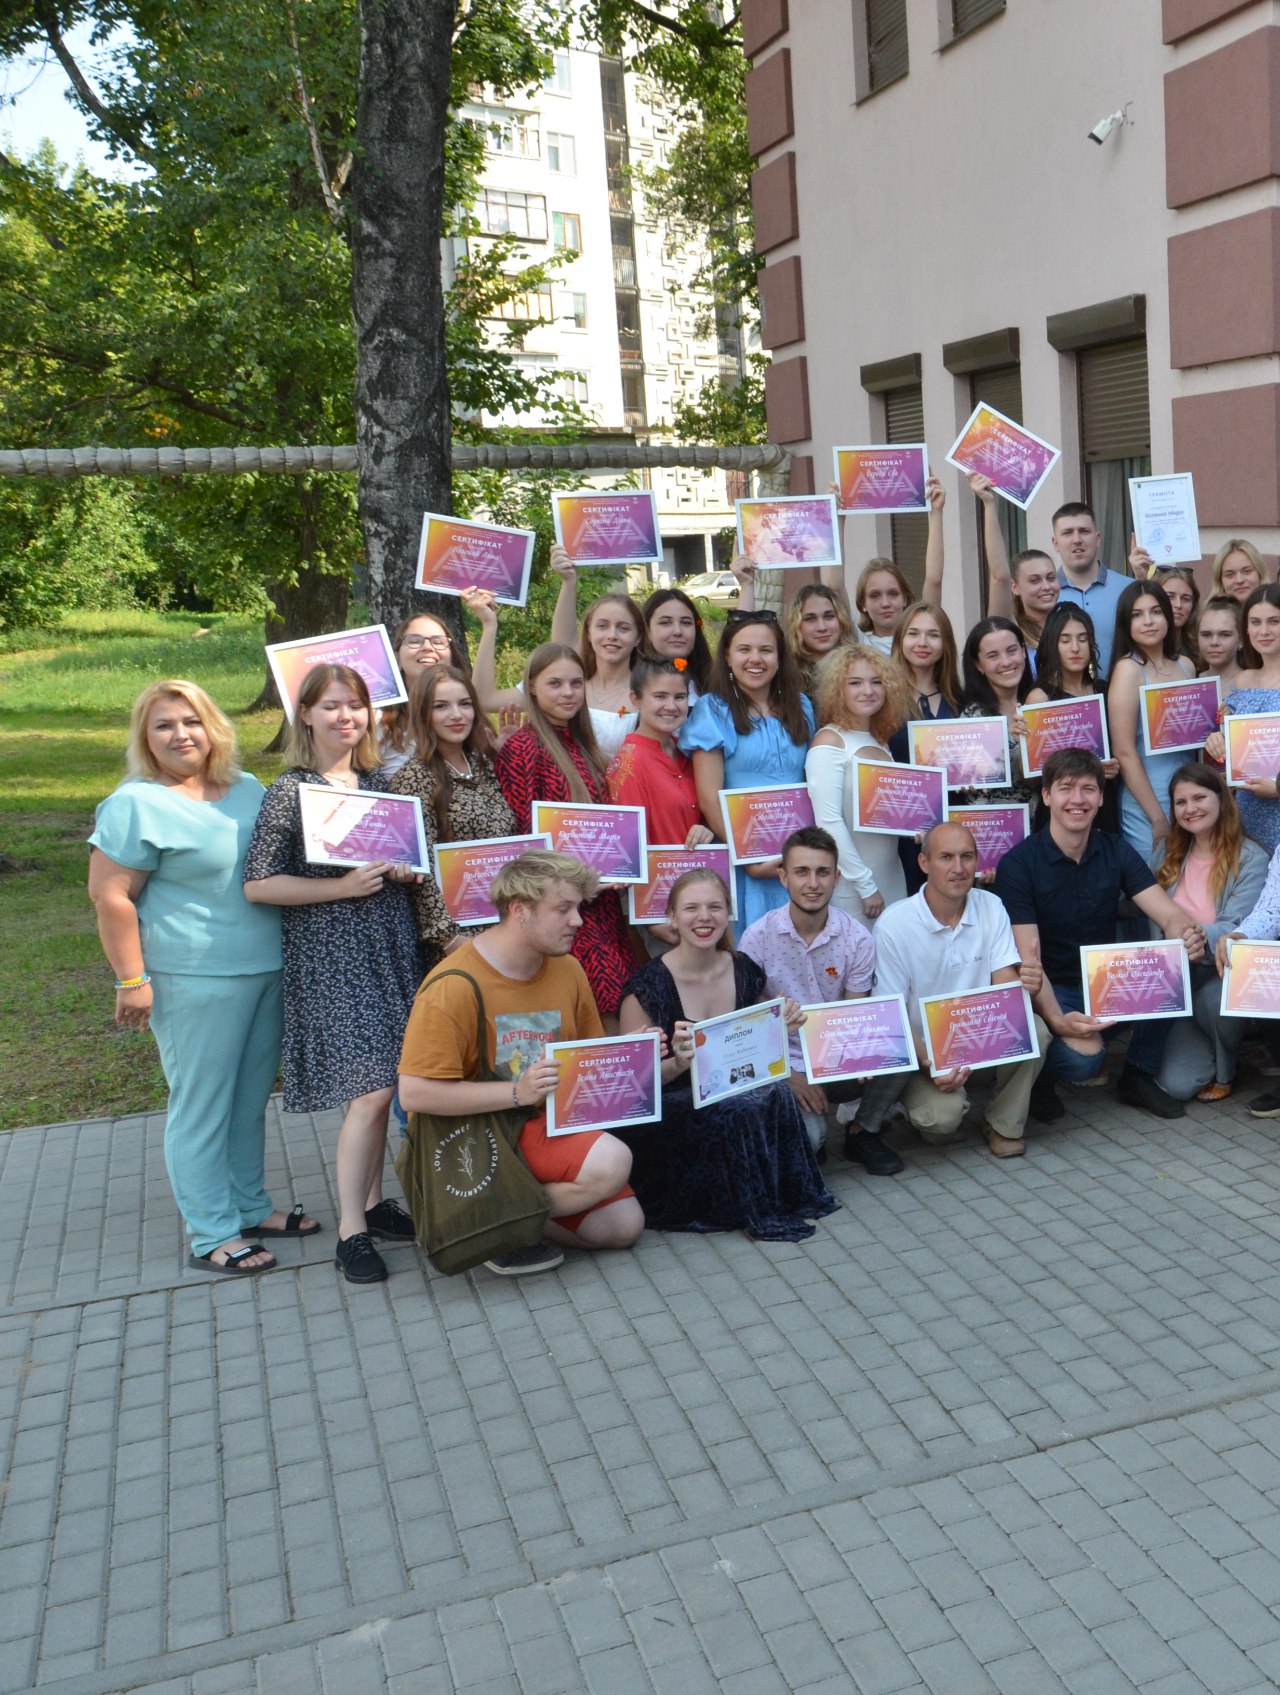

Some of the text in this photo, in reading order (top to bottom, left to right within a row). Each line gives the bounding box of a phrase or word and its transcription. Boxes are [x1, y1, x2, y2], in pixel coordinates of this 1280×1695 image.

[452, 534, 502, 549] СЕРТИФІКАТ
[1164, 694, 1200, 703] СЕРТИФІКАТ
[1043, 713, 1082, 724] СЕРТИФІКАТ
[936, 733, 981, 741] СЕРТИФІКАТ
[879, 777, 922, 786] СЕРТИФІКАТ
[750, 801, 793, 809] СЕРТИФІКАТ
[563, 820, 614, 828] СЕРТИФІКАТ
[599, 832, 620, 842] Марія
[1110, 958, 1158, 967] СЕРТИФІКАТ
[951, 1002, 1000, 1017] СЕРТИФІКАТ
[827, 1014, 877, 1025] СЕРТИФІКАТ
[723, 1028, 754, 1044] ДИПЛОМ
[579, 1056, 630, 1067] СЕРТИФІКАТ
[434, 1123, 470, 1172] LOVE PLANET
[445, 1175, 493, 1198] ESSENTIALS
